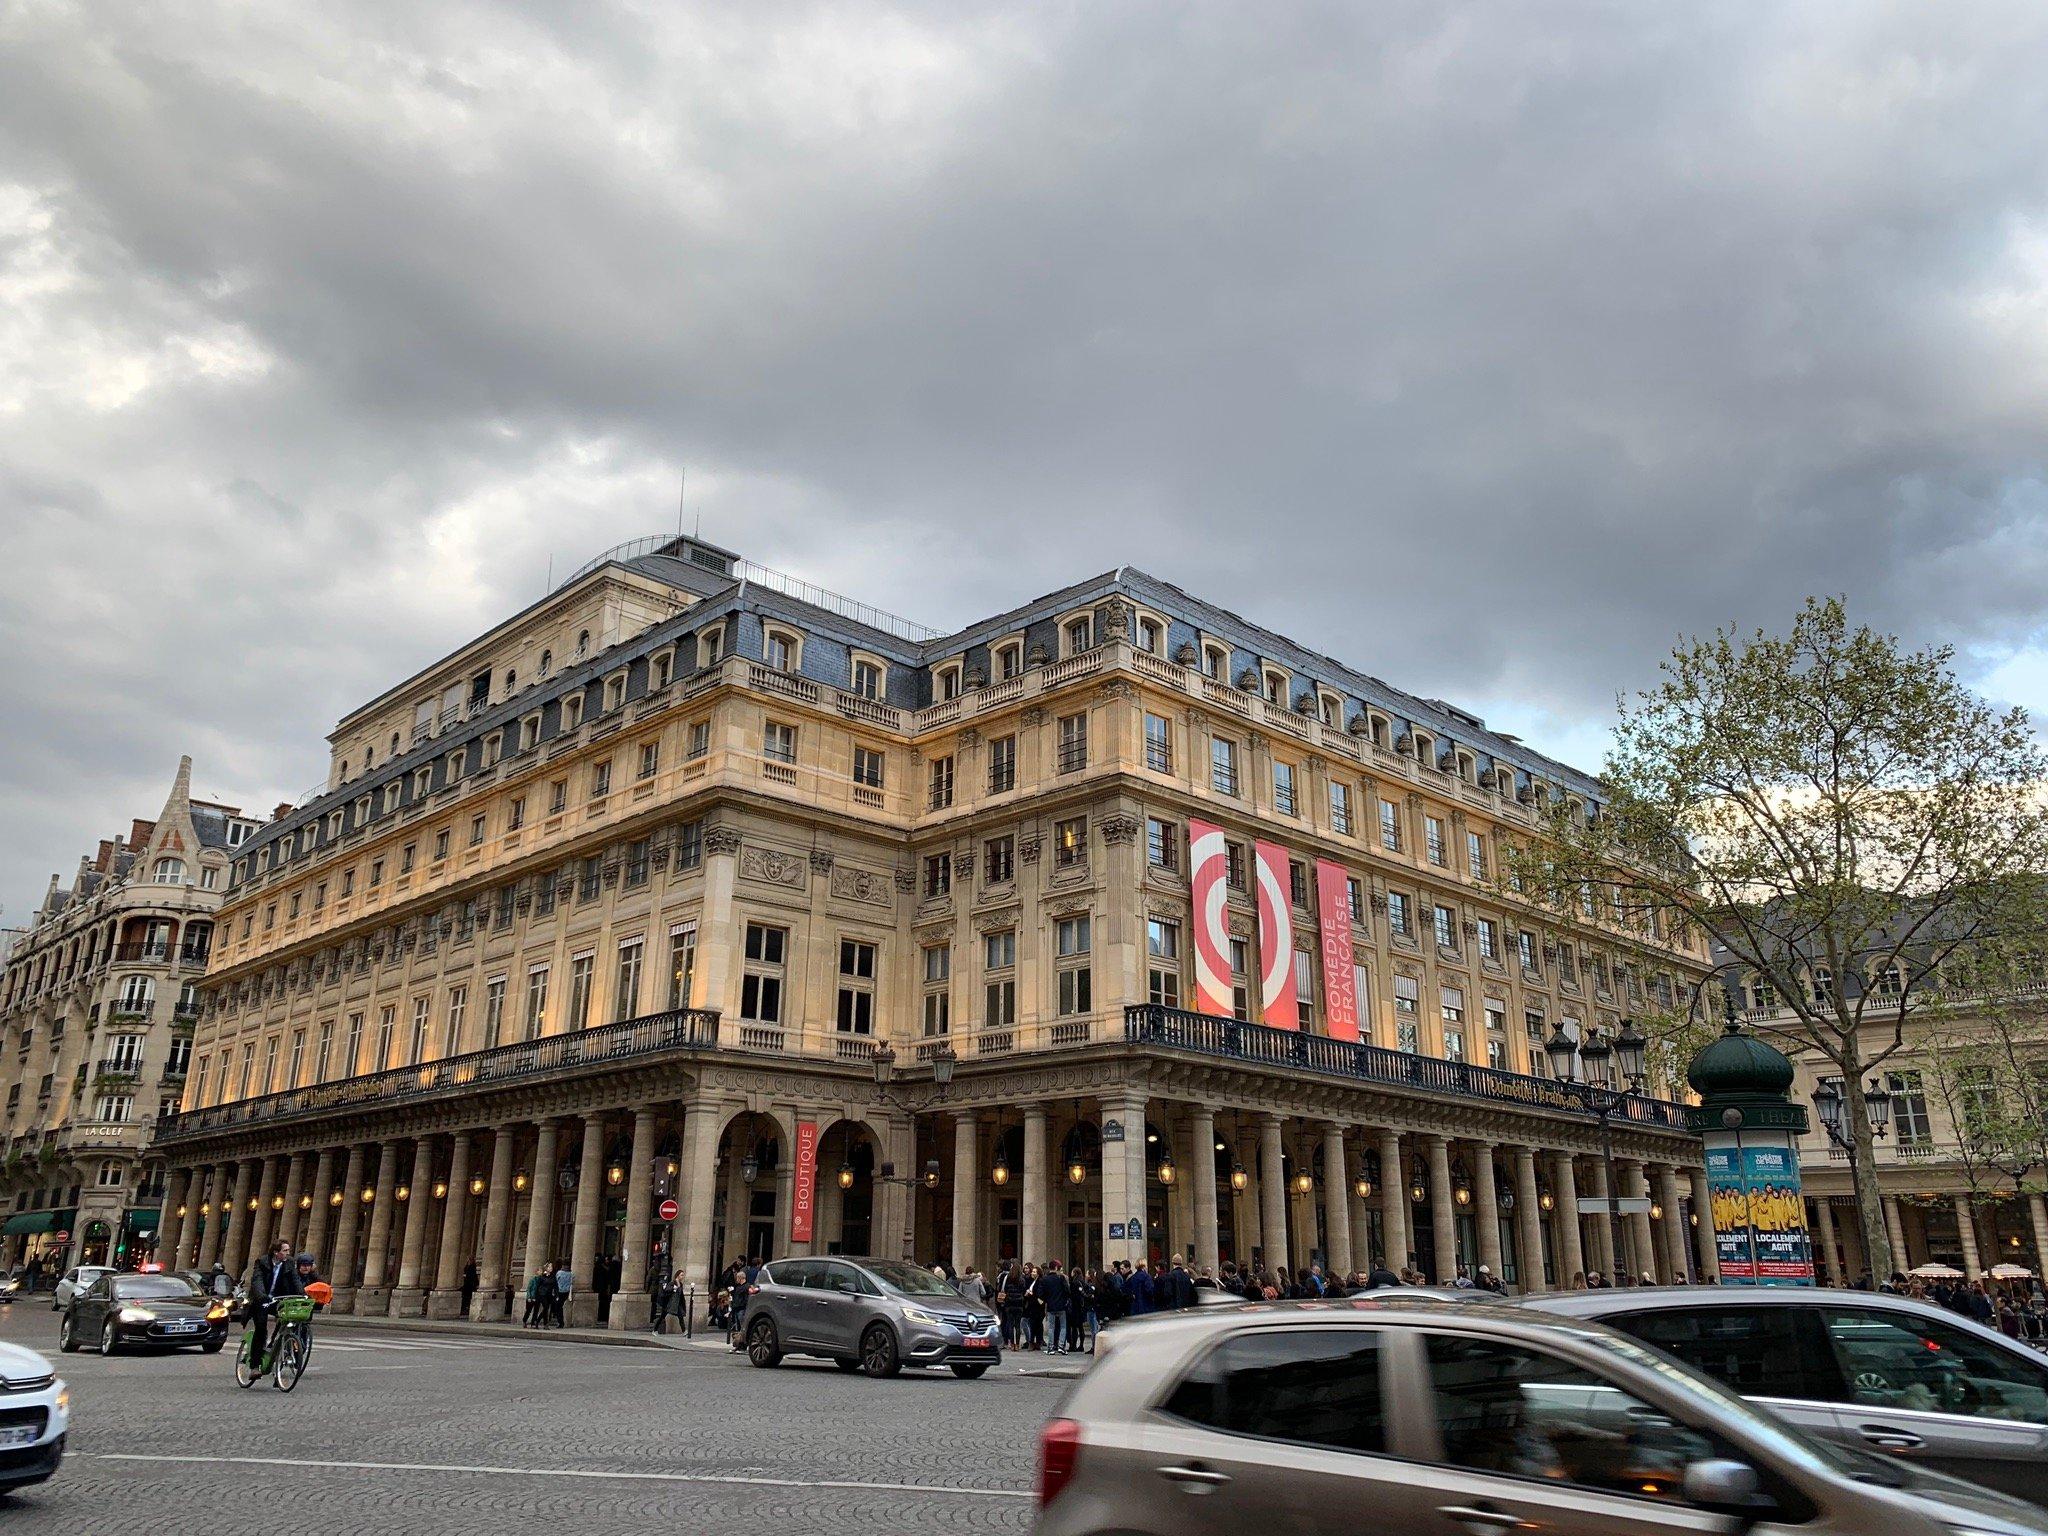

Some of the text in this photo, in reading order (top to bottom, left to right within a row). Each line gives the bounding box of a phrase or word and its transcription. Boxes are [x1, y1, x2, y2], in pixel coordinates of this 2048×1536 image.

[1325, 917, 1342, 1023] COMÉDIE
[1335, 895, 1355, 1025] FRANÇAISE
[85, 1127, 123, 1136] LA CLEF
[797, 1129, 813, 1210] BOUTIQUE
[1755, 1234, 1801, 1243] LOCALEMENT
[1771, 1241, 1793, 1252] AGITÉ
